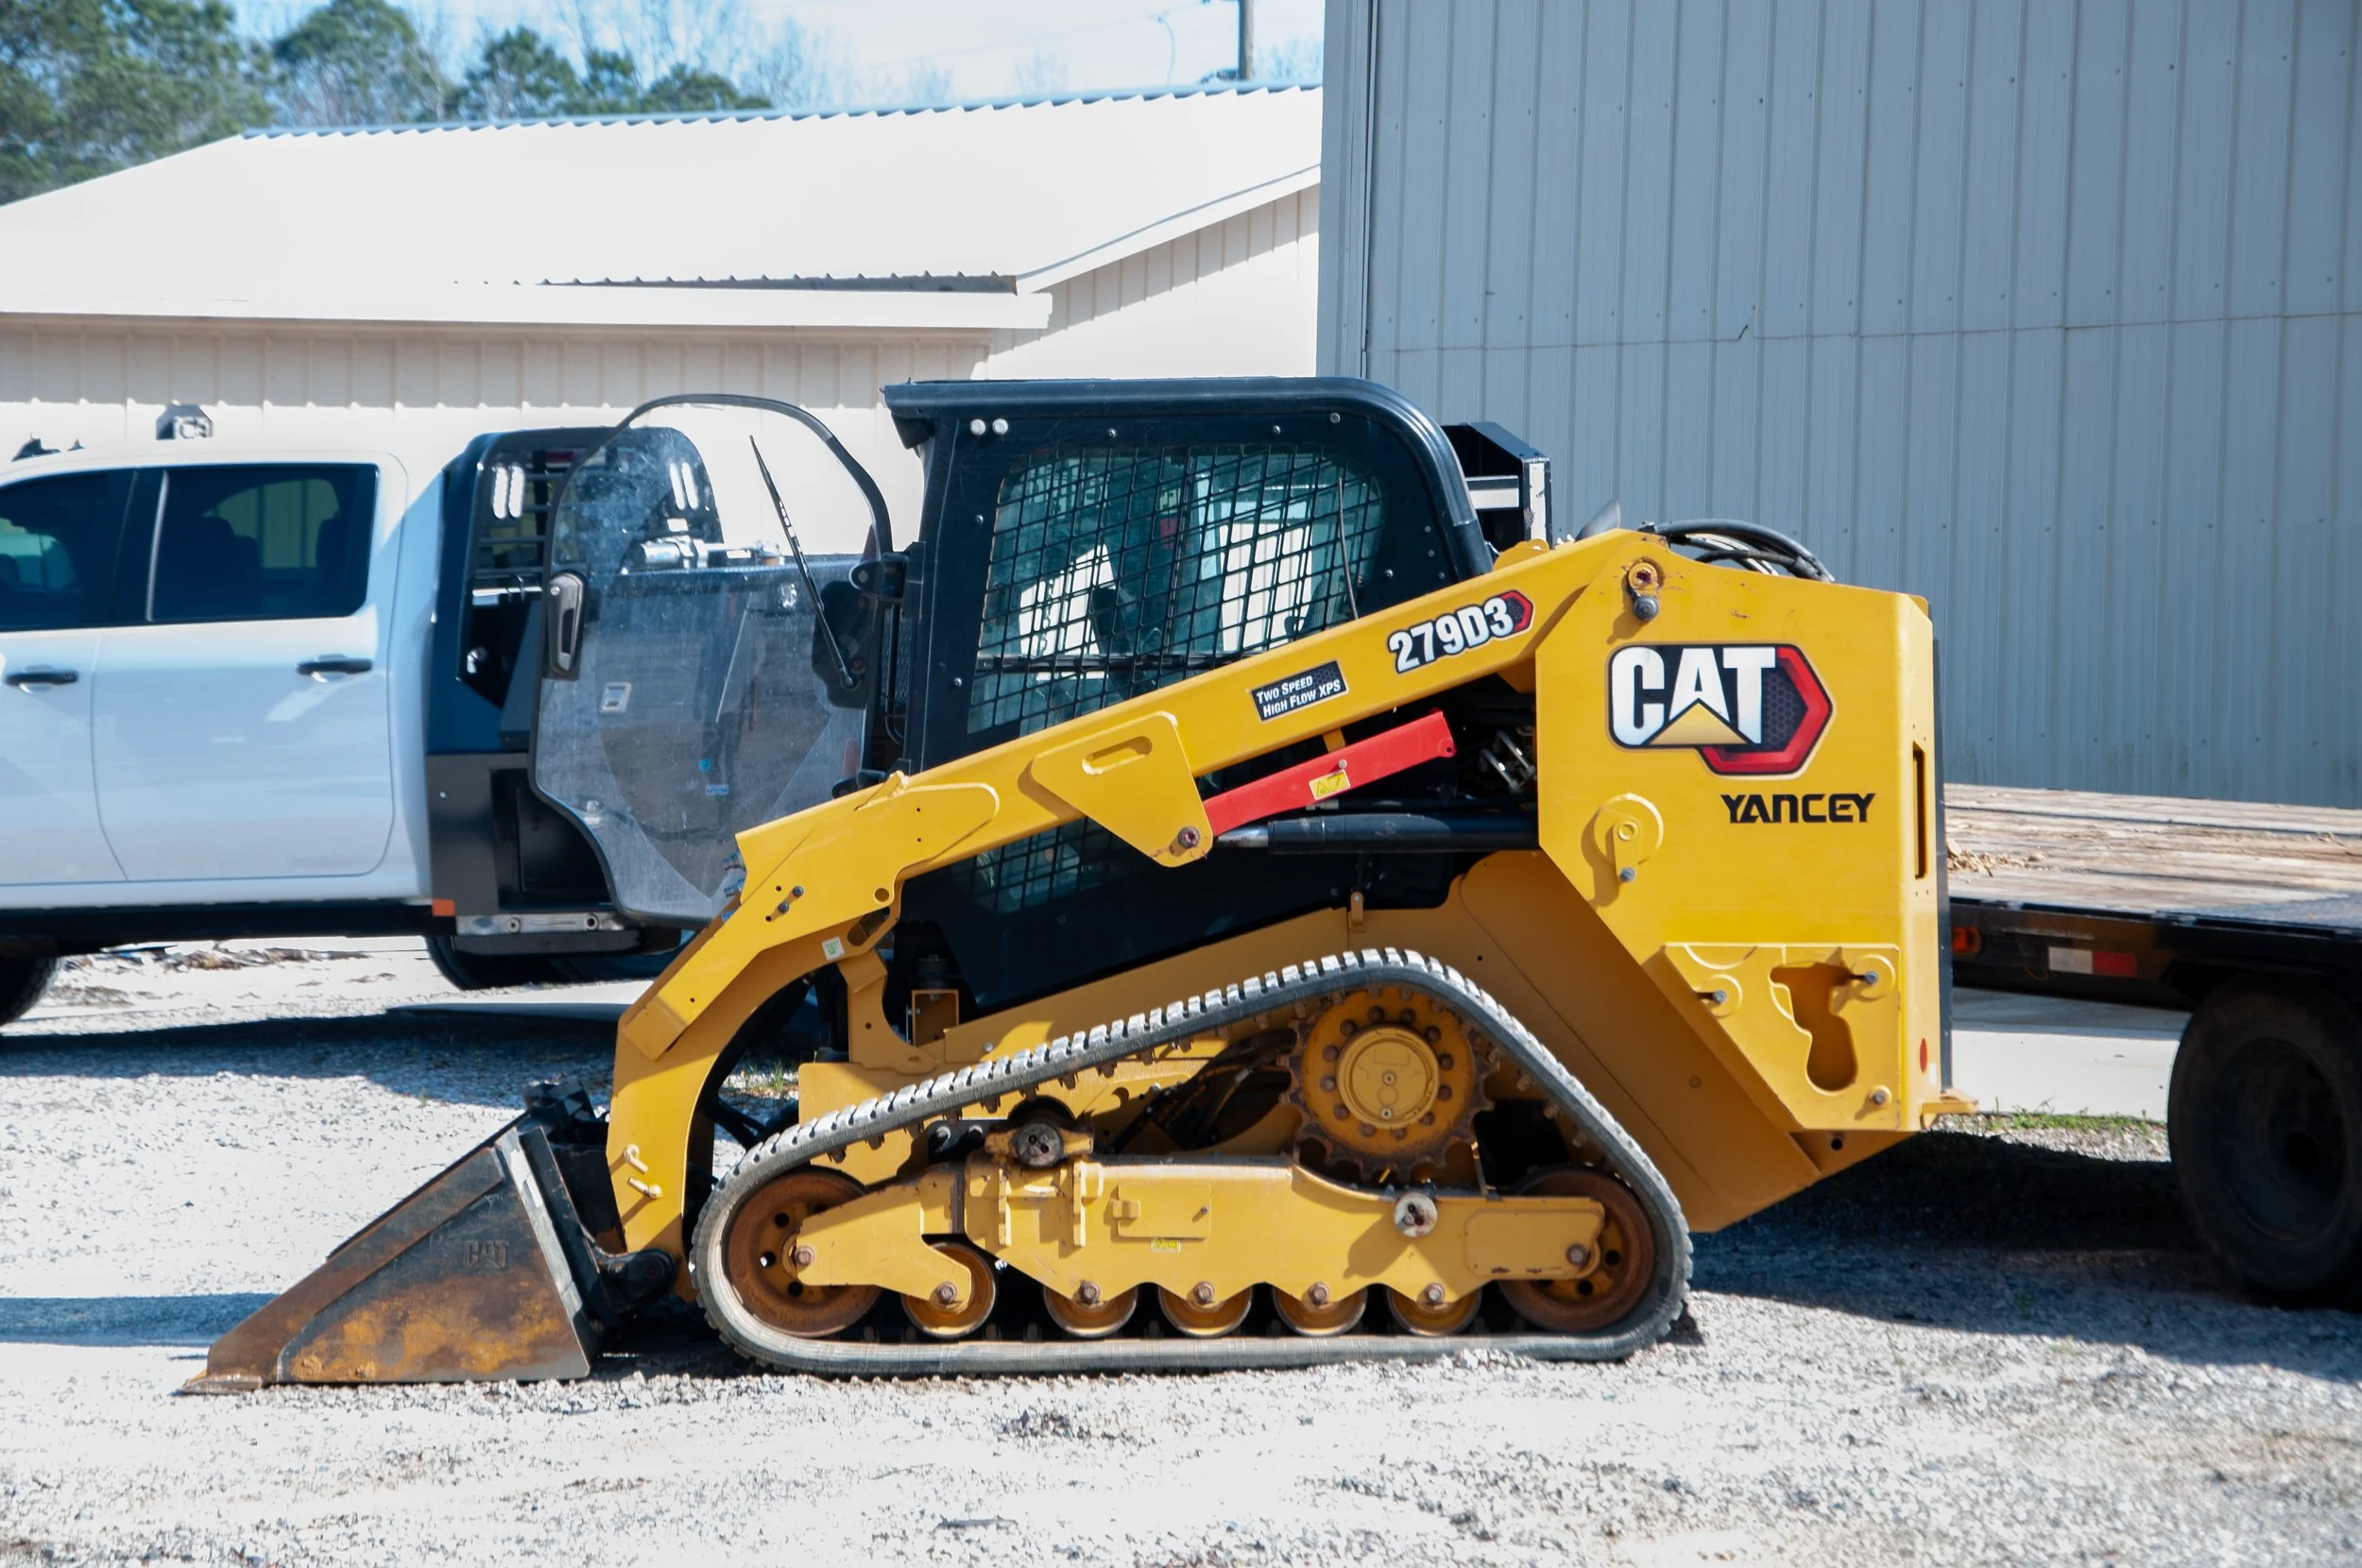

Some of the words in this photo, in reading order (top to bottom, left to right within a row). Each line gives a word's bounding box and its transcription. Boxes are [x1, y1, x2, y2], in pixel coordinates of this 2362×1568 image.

[1389, 597, 1514, 673] 279D3
[1318, 679, 1342, 697] XPS
[1612, 647, 1776, 745] CAT
[1720, 793, 1876, 824] YANCEY
[462, 1239, 510, 1269] CAT
